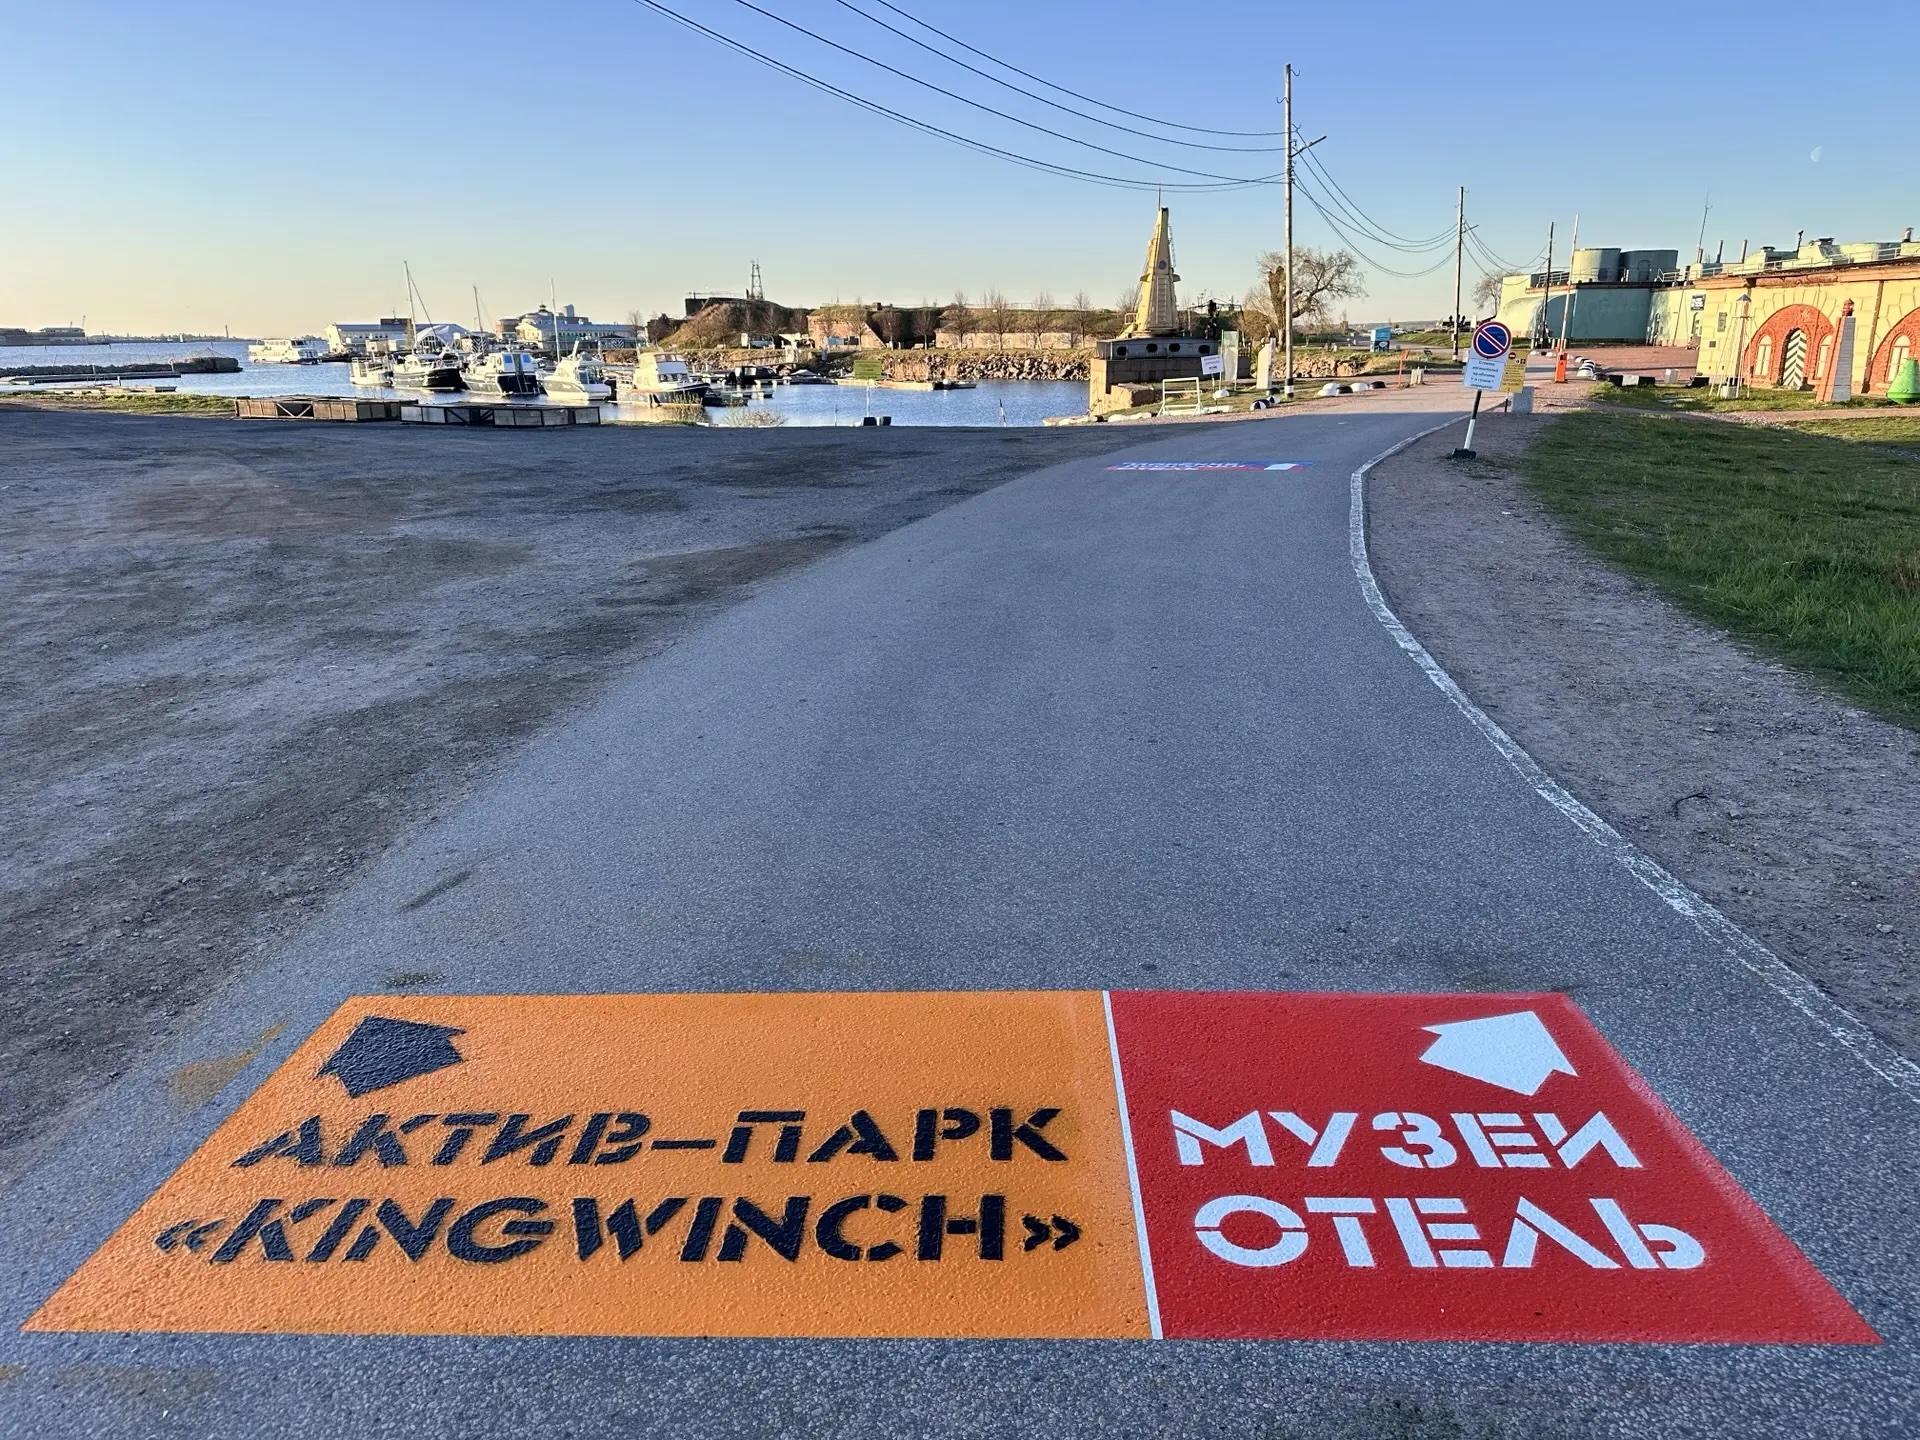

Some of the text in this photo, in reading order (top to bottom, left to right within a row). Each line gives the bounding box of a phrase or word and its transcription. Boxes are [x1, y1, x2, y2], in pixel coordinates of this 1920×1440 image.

[231, 1106, 1068, 1169] АКТИВ-ПАРК
[1170, 1110, 1642, 1169] МУЗЕИ
[155, 1192, 1082, 1265] «KINGWINCH»
[1195, 1195, 1706, 1269] ОТЕЛЬ
